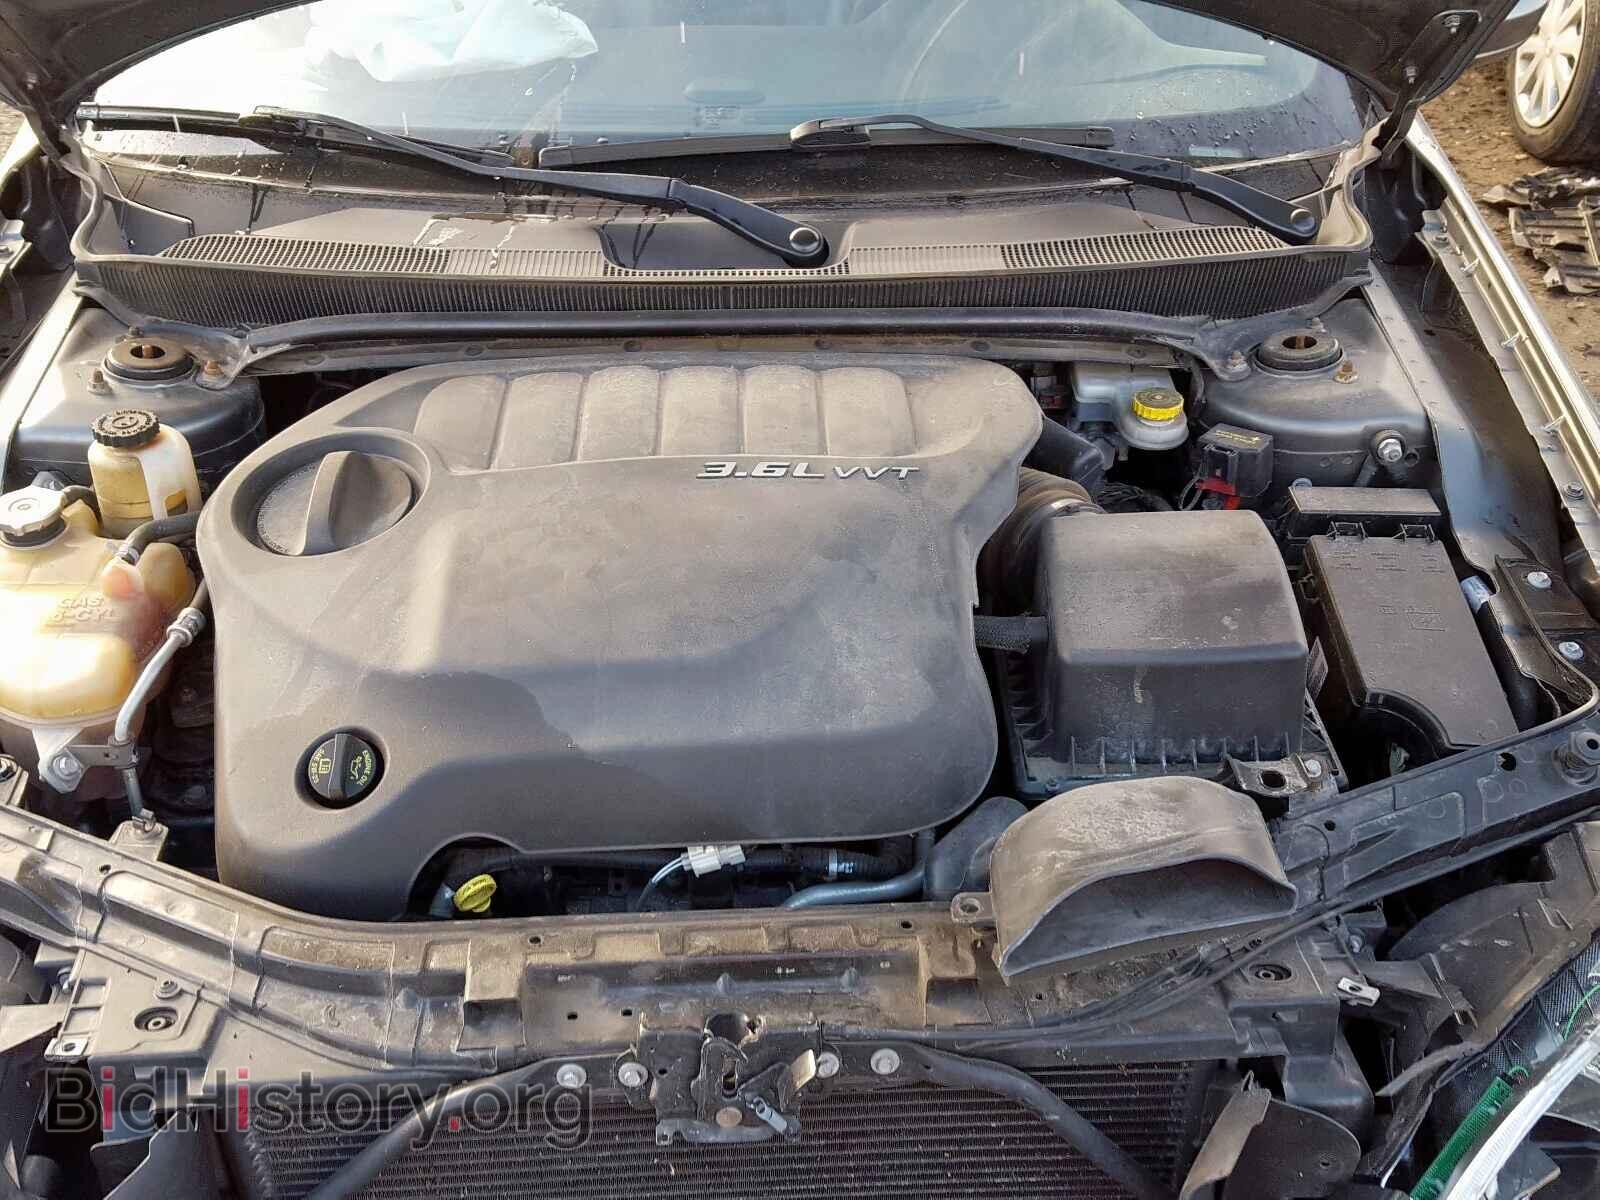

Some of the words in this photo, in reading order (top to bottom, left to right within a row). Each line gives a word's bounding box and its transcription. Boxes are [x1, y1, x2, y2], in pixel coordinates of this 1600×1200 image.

[696, 461, 825, 479] 3.6L
[833, 466, 920, 480] VVT
[362, 749, 372, 774] ENGINE
[356, 775, 368, 786] OIL
